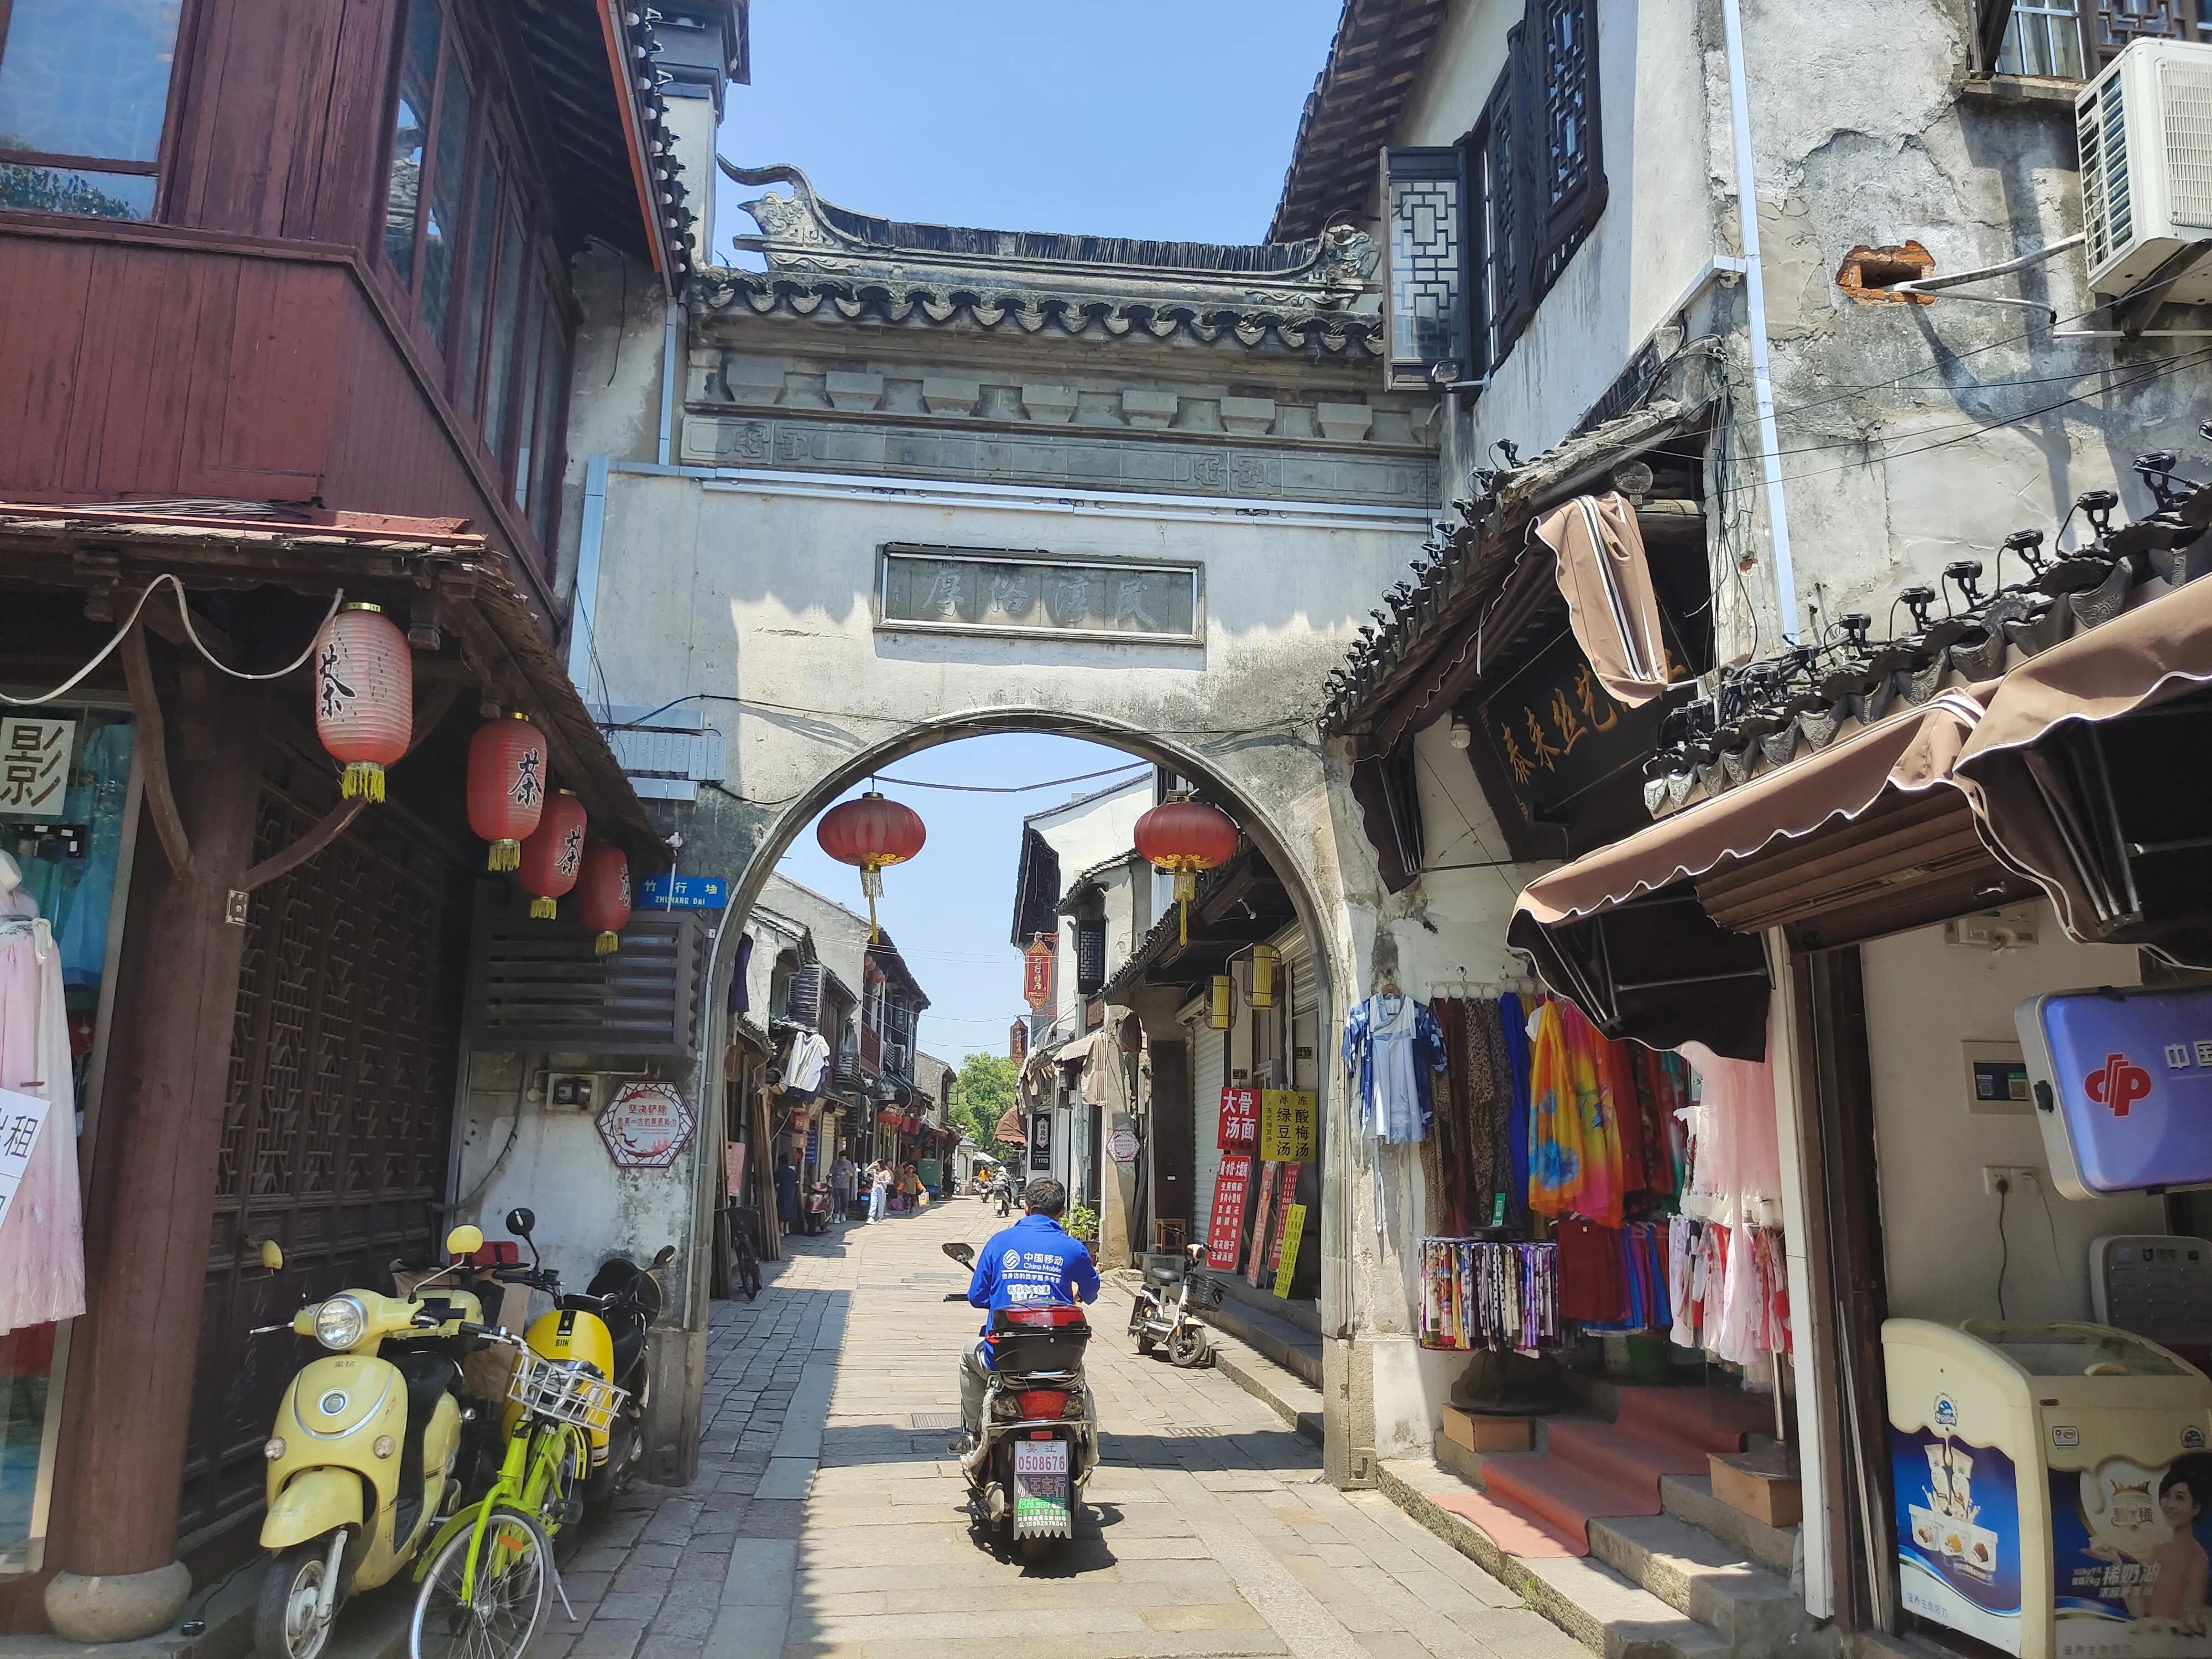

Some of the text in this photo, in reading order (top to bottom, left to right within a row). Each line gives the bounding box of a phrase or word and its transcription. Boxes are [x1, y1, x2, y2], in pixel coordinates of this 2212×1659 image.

[319, 644, 358, 721] 茶
[1, 725, 65, 806] 影
[507, 748, 544, 808] 茶
[555, 825, 582, 877] 茶
[2163, 1040, 2212, 1069] 中国
[1222, 1090, 1253, 1115] 大骨
[1225, 1115, 1257, 1141] 汤面
[1024, 1252, 1064, 1266] 中国移动
[1042, 1265, 1062, 1273] Mobile
[1018, 1456, 1065, 1470] 0508676
[1017, 1476, 1066, 1498] 小王车行
